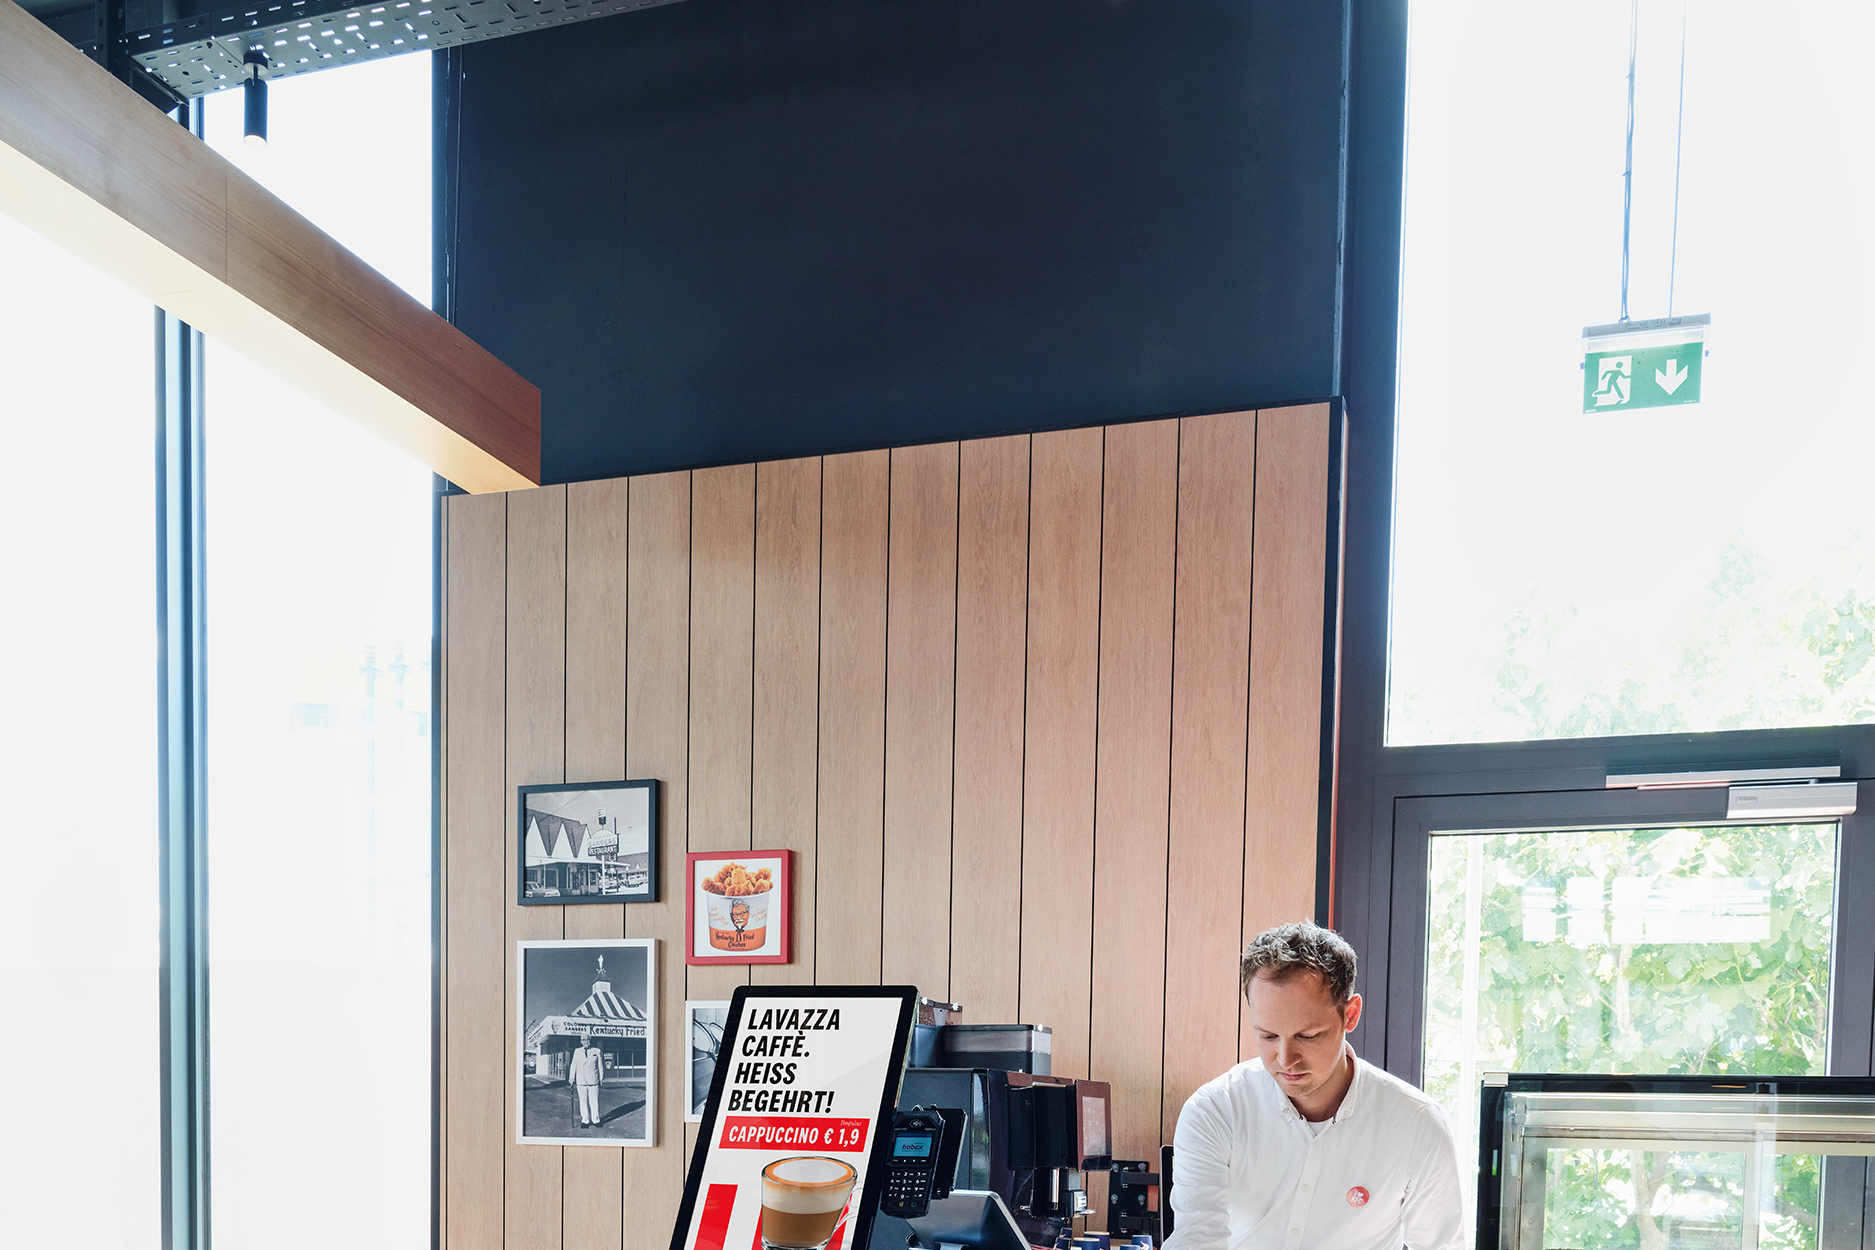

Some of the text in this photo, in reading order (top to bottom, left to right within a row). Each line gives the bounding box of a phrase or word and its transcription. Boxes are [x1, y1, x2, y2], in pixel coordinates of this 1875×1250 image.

[590, 1023, 645, 1037] Kentucky Fried
[747, 1008, 840, 1031] LAVAZZA
[742, 1030, 810, 1057] CAFFÈ.
[734, 1062, 798, 1085] HEISS
[728, 1089, 835, 1114] BEGEHRT!
[728, 1125, 860, 1147] CAPPUCCINO € 1,9
[1351, 1196, 1363, 1204] KFC
